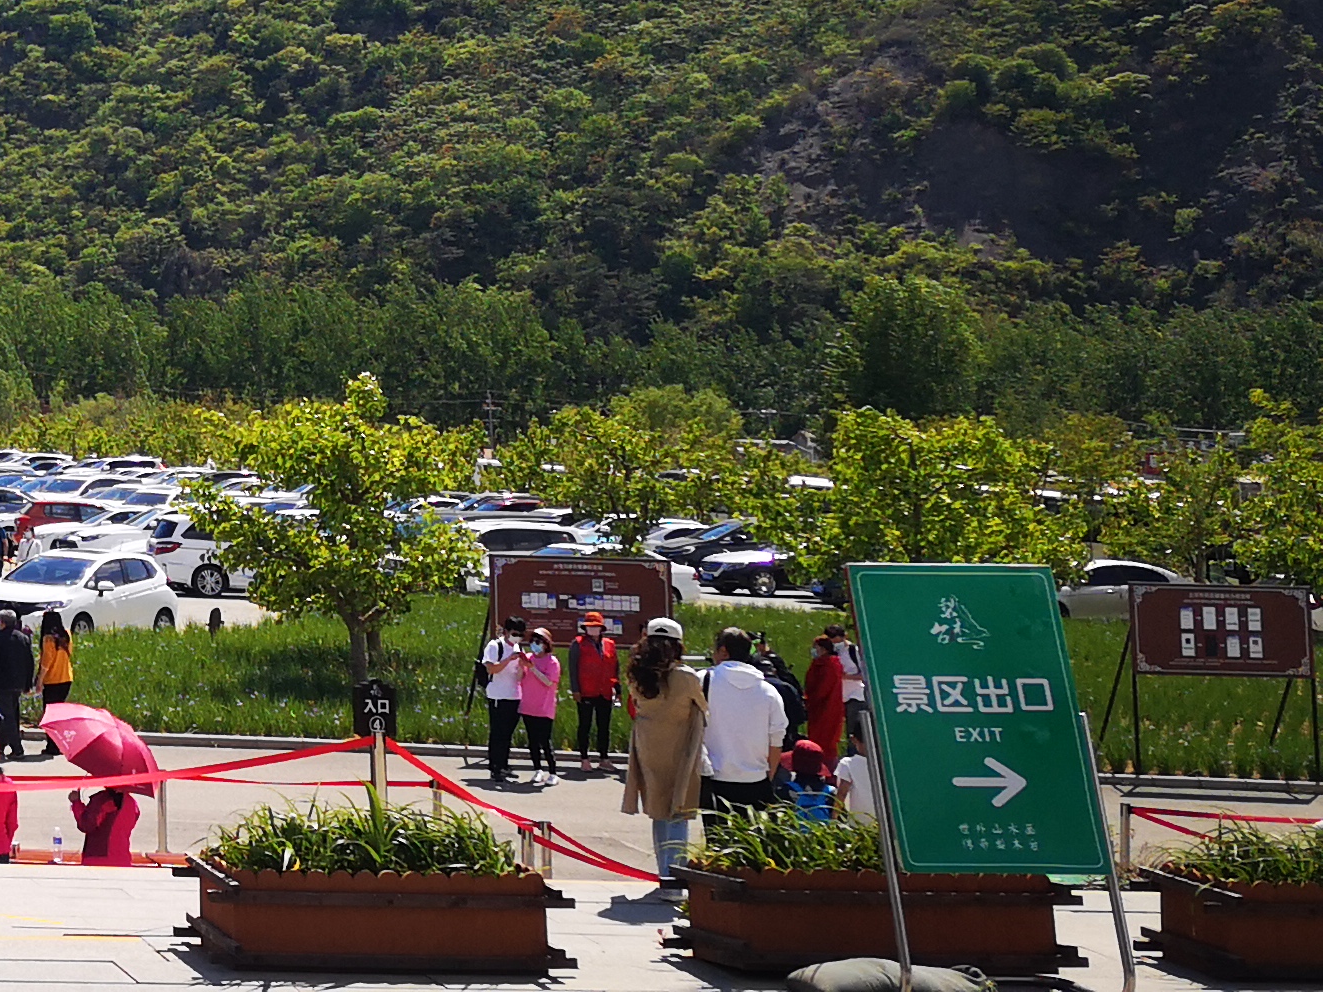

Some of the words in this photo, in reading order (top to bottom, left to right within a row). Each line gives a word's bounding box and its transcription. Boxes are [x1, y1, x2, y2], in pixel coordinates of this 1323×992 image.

[892, 675, 1054, 713] 景区出口
[363, 699, 390, 714] 入口
[954, 727, 1003, 743] EXIT
